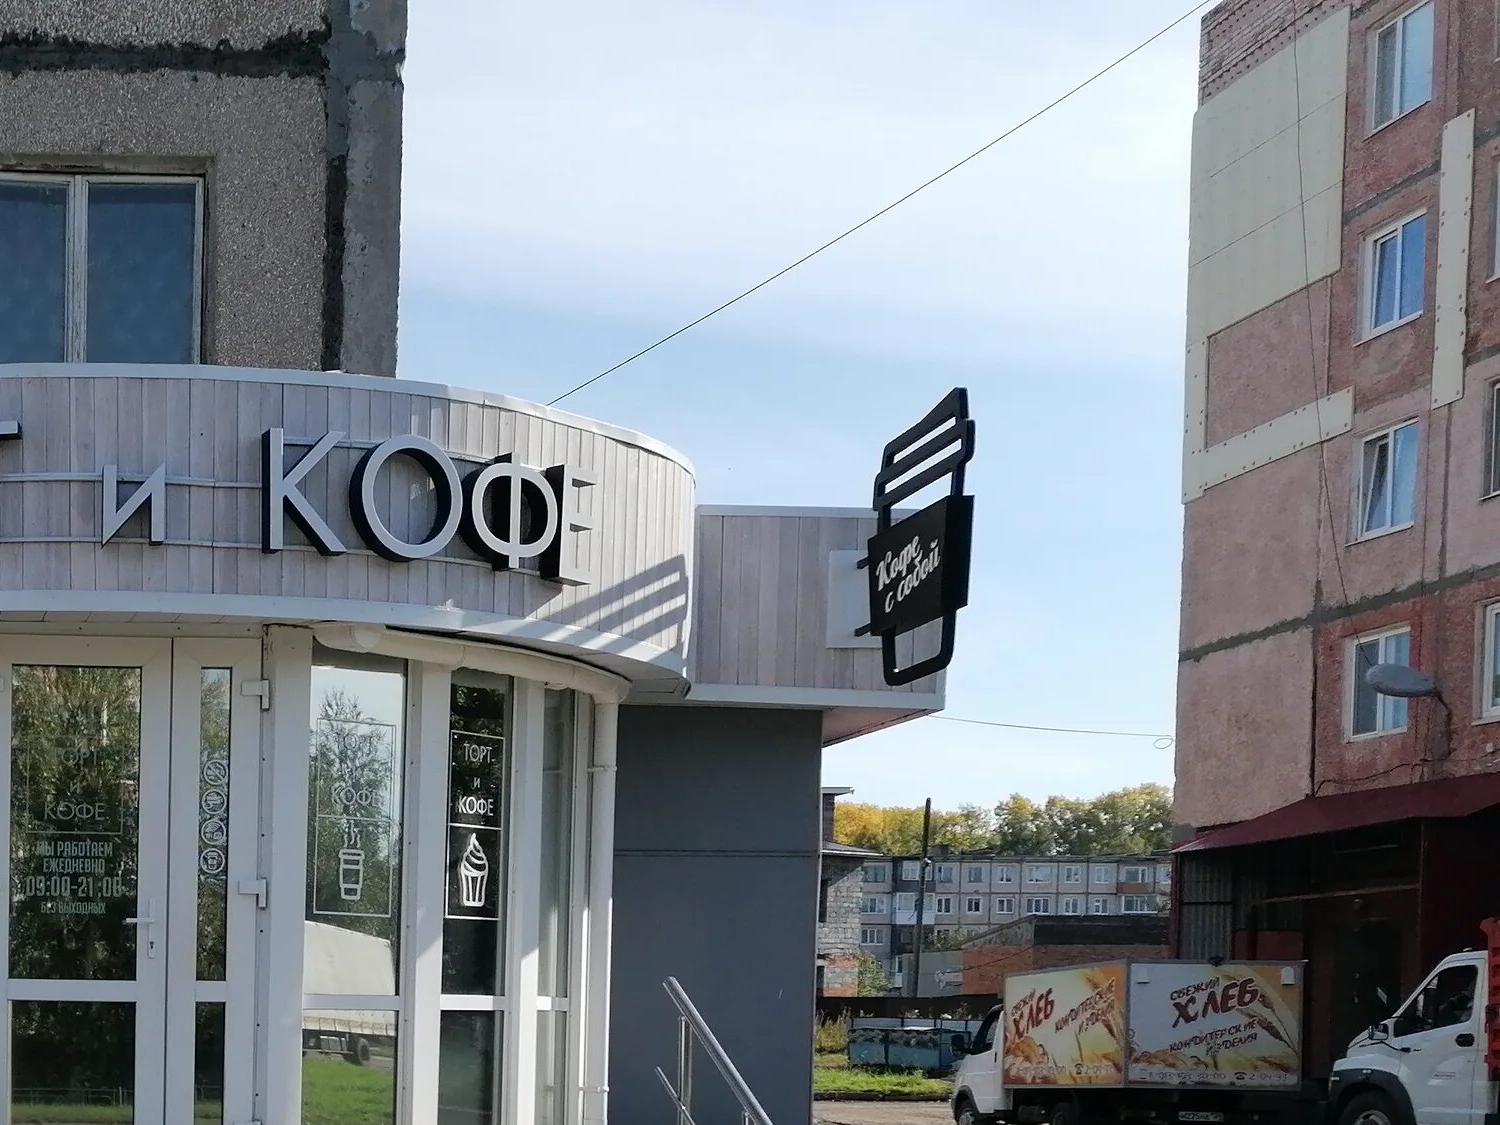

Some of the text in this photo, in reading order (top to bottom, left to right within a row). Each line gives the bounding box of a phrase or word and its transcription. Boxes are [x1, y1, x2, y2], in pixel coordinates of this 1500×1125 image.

[261, 427, 599, 586] КОФЕ
[876, 535, 921, 591] Кофе
[897, 538, 941, 602] собой
[464, 743, 492, 763] ТОРТ
[44, 802, 105, 821] КОФЕ
[459, 796, 494, 816] КОФЕ
[43, 858, 106, 874] ЕЖЕДНЕВНО
[57, 840, 113, 857] РАБОТАЕМ
[1012, 987, 1055, 1041] ХЛЕБ
[1171, 978, 1259, 1028] ХЛЕБ
